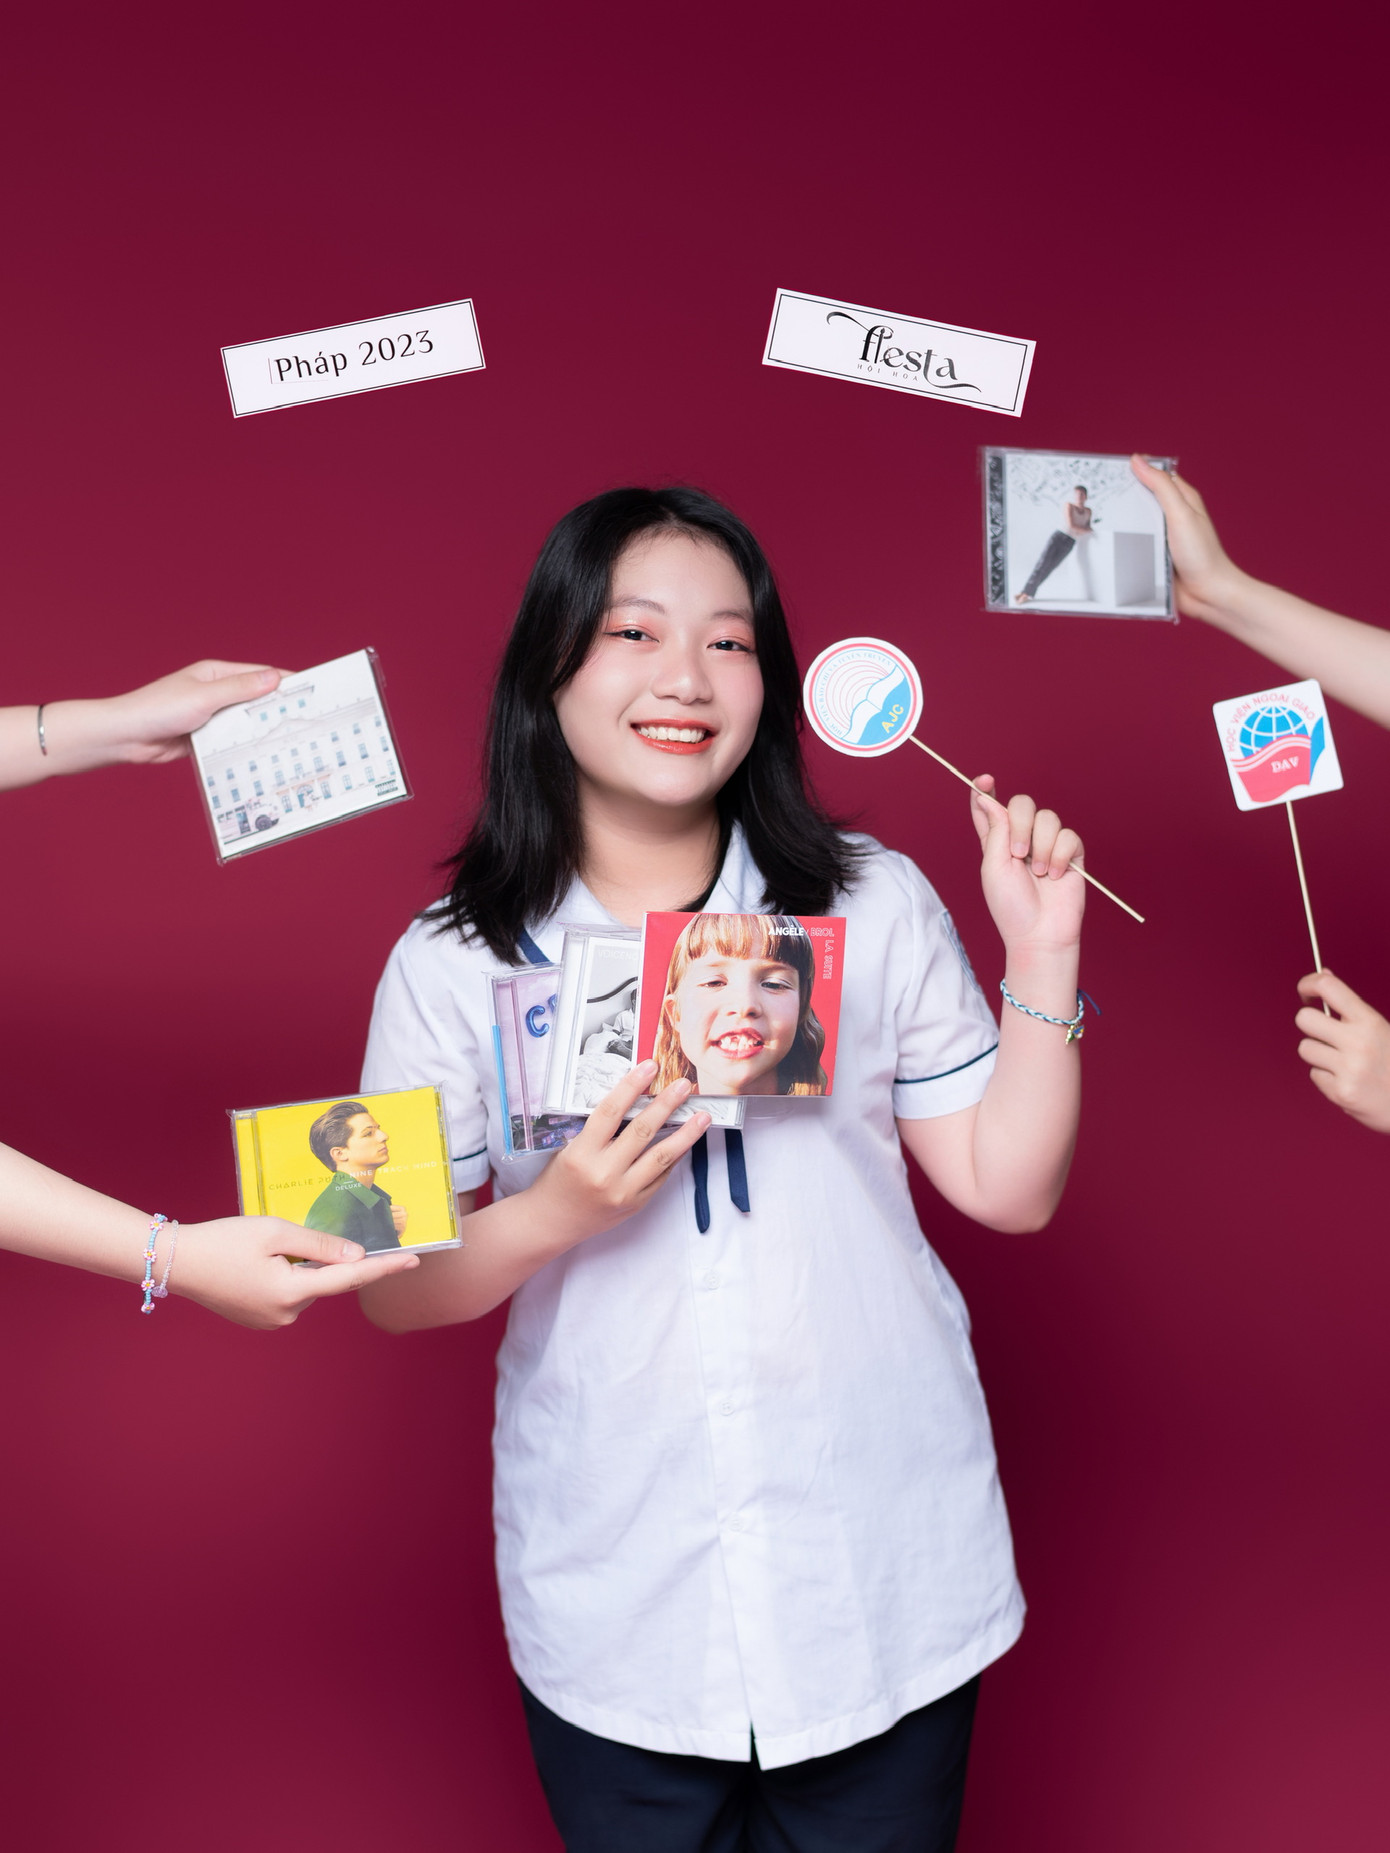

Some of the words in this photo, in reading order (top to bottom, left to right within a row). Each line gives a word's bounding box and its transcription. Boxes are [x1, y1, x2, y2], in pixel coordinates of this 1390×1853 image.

[274, 351, 348, 382] Pháp
[358, 329, 434, 366] 2023
[881, 704, 904, 734] AJC
[1271, 756, 1299, 774] DAV
[768, 925, 804, 936] ANGÈLE
[811, 927, 834, 937] BROL
[598, 950, 639, 961] VOICENO
[825, 940, 834, 953] LA
[823, 955, 833, 979] SUITE
[268, 1177, 314, 1191] CHARLIE
[349, 1169, 373, 1179] NINE
[335, 1182, 362, 1192] DELUXE
